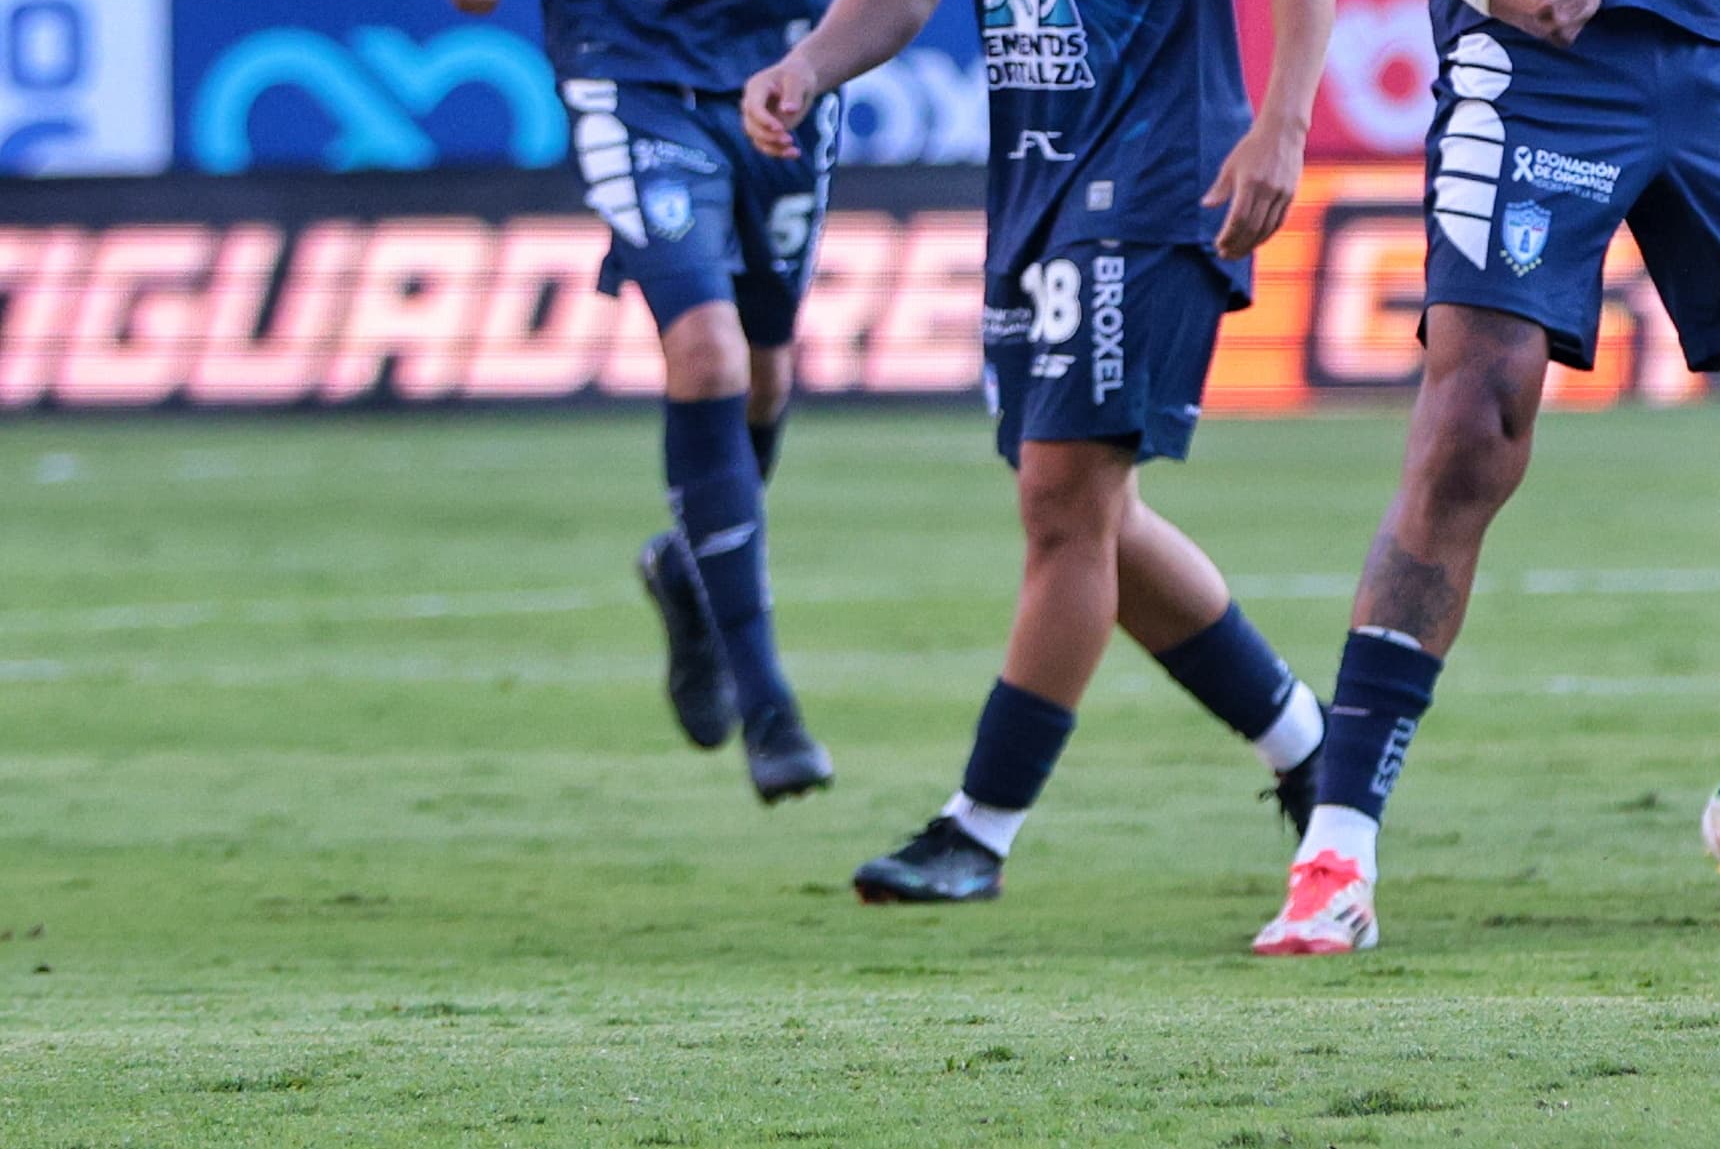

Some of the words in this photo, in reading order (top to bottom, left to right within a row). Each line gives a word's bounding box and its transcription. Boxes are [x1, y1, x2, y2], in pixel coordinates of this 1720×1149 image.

[1535, 149, 1622, 182] DONACIÓN
[1020, 257, 1082, 344] 18
[1091, 255, 1125, 405] BROXEL
